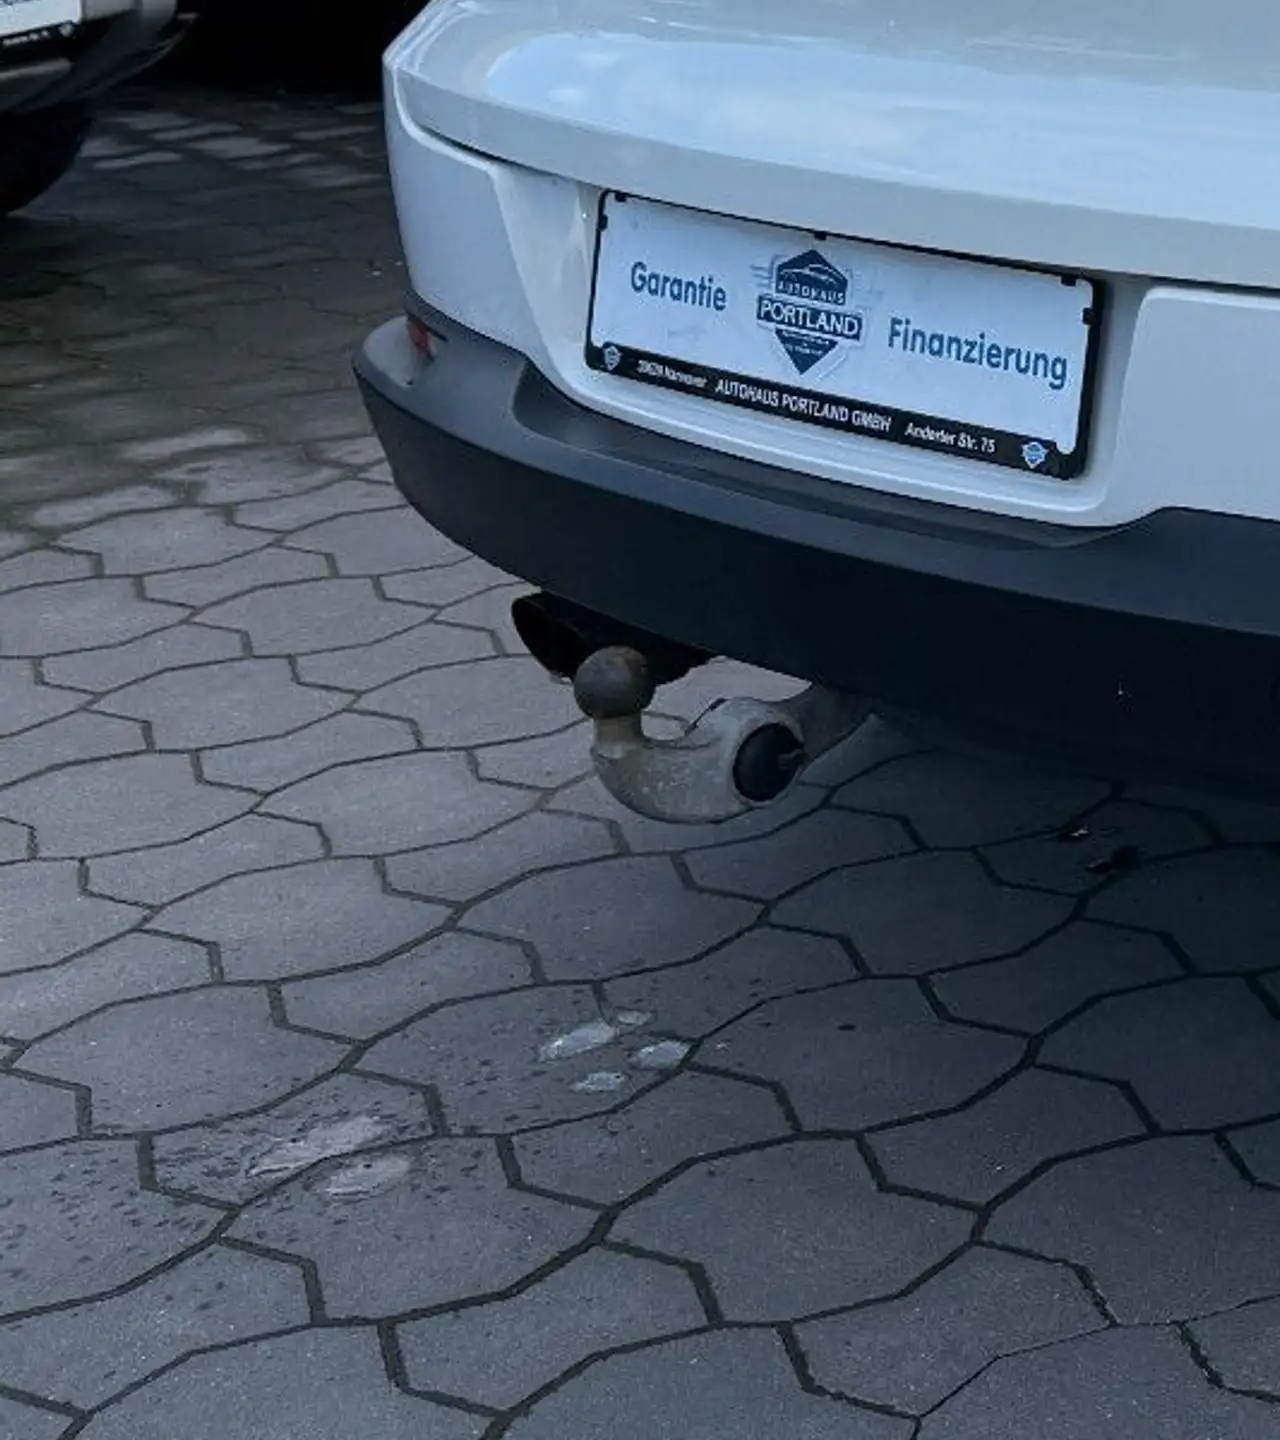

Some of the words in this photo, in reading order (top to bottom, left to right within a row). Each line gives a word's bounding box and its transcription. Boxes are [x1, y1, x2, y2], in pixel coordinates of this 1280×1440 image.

[631, 261, 727, 312] Garantie
[760, 299, 859, 336] PORTLAND
[888, 317, 1067, 390] Finanzierung
[715, 379, 779, 407] AUTOHAUS
[781, 393, 849, 422] PORTLAND
[851, 411, 893, 433] GMBH
